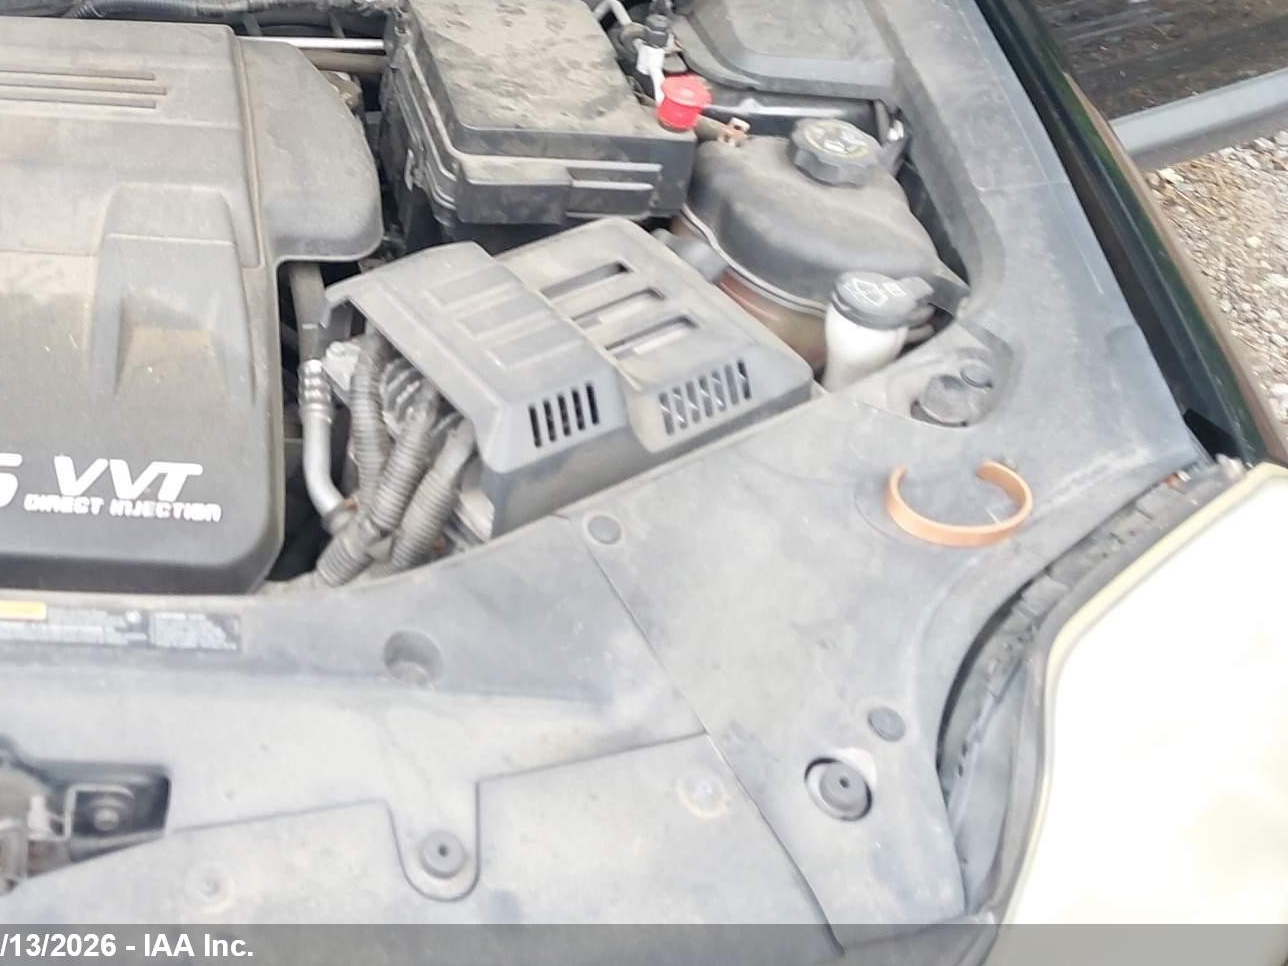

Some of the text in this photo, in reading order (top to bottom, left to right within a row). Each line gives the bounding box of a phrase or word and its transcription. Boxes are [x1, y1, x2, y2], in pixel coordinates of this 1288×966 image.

[54, 455, 203, 502] VVT
[23, 493, 221, 522] DIRECT INJECTION
